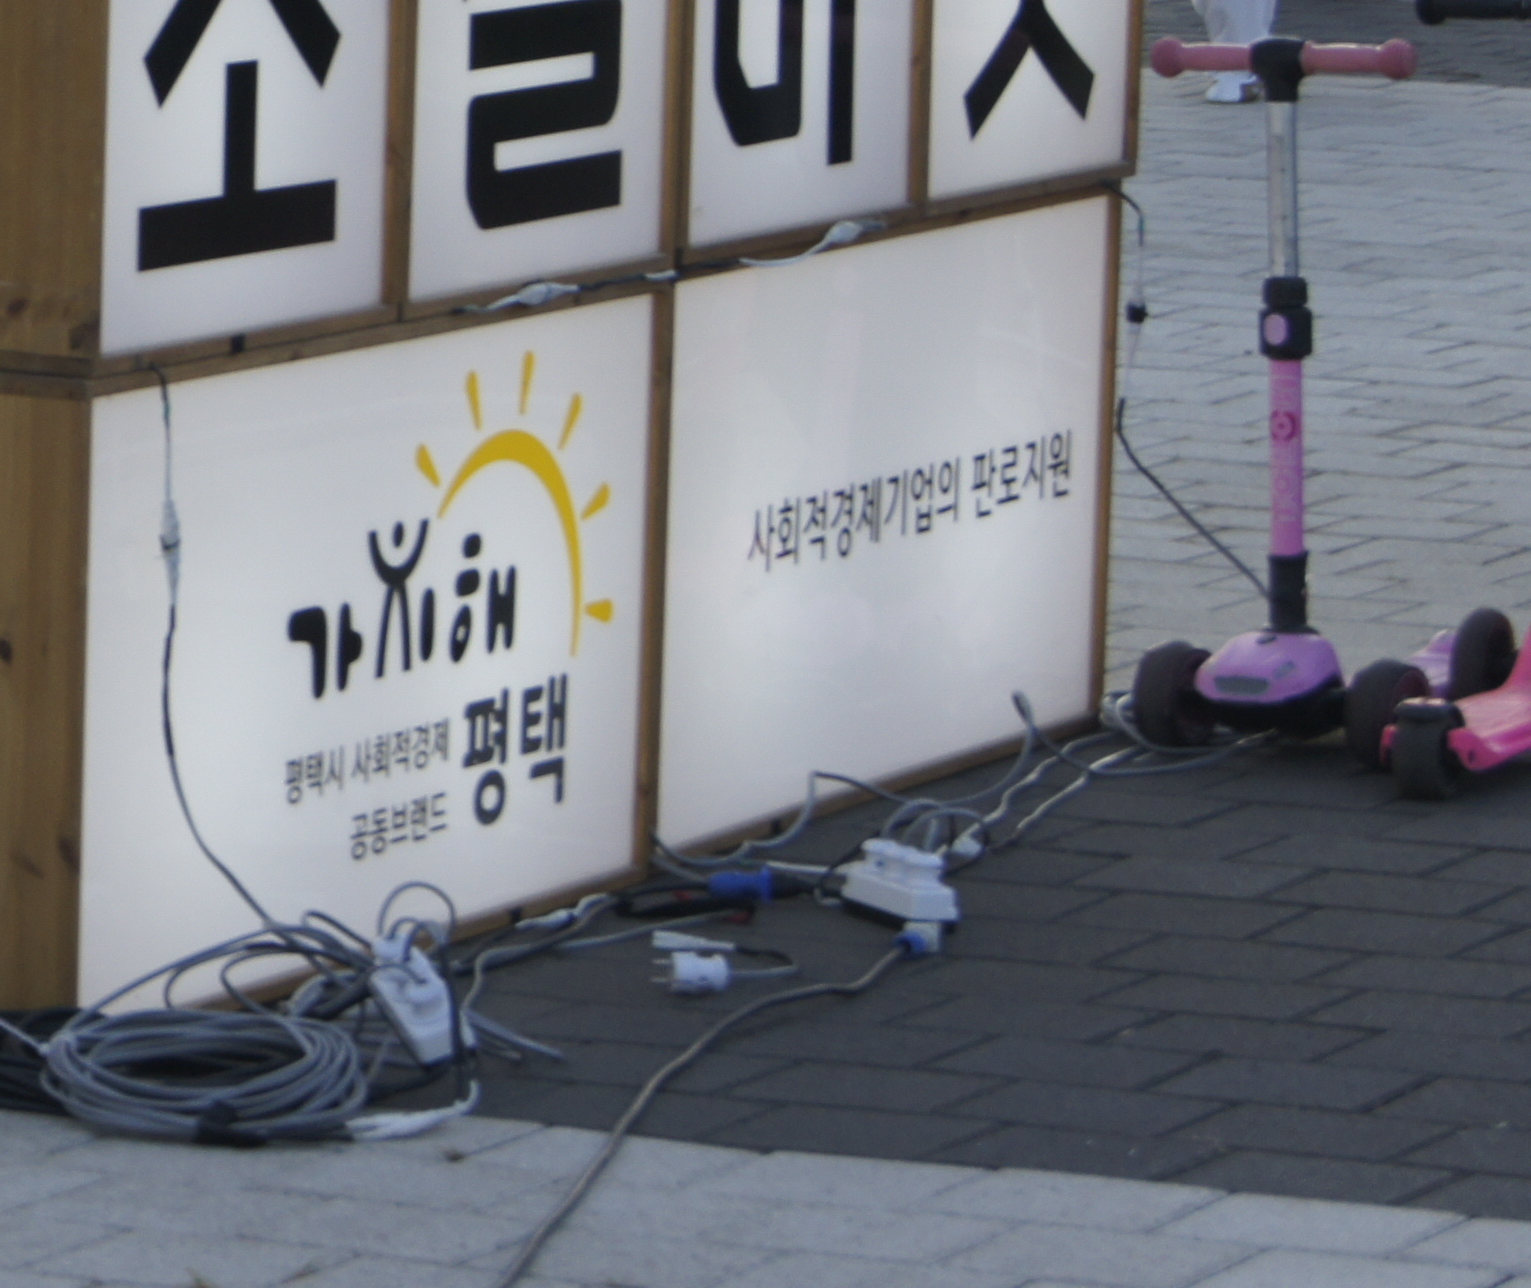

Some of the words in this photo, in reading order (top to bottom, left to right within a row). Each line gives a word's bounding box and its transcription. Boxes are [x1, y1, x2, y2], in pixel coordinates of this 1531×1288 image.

[746, 456, 961, 575] 사회적경제기업의
[970, 427, 1073, 520] 판로지원
[284, 743, 347, 807] 평택시
[350, 716, 451, 785] 사회적경제
[461, 670, 570, 829] 평택
[349, 790, 451, 862] 공동브랜드
